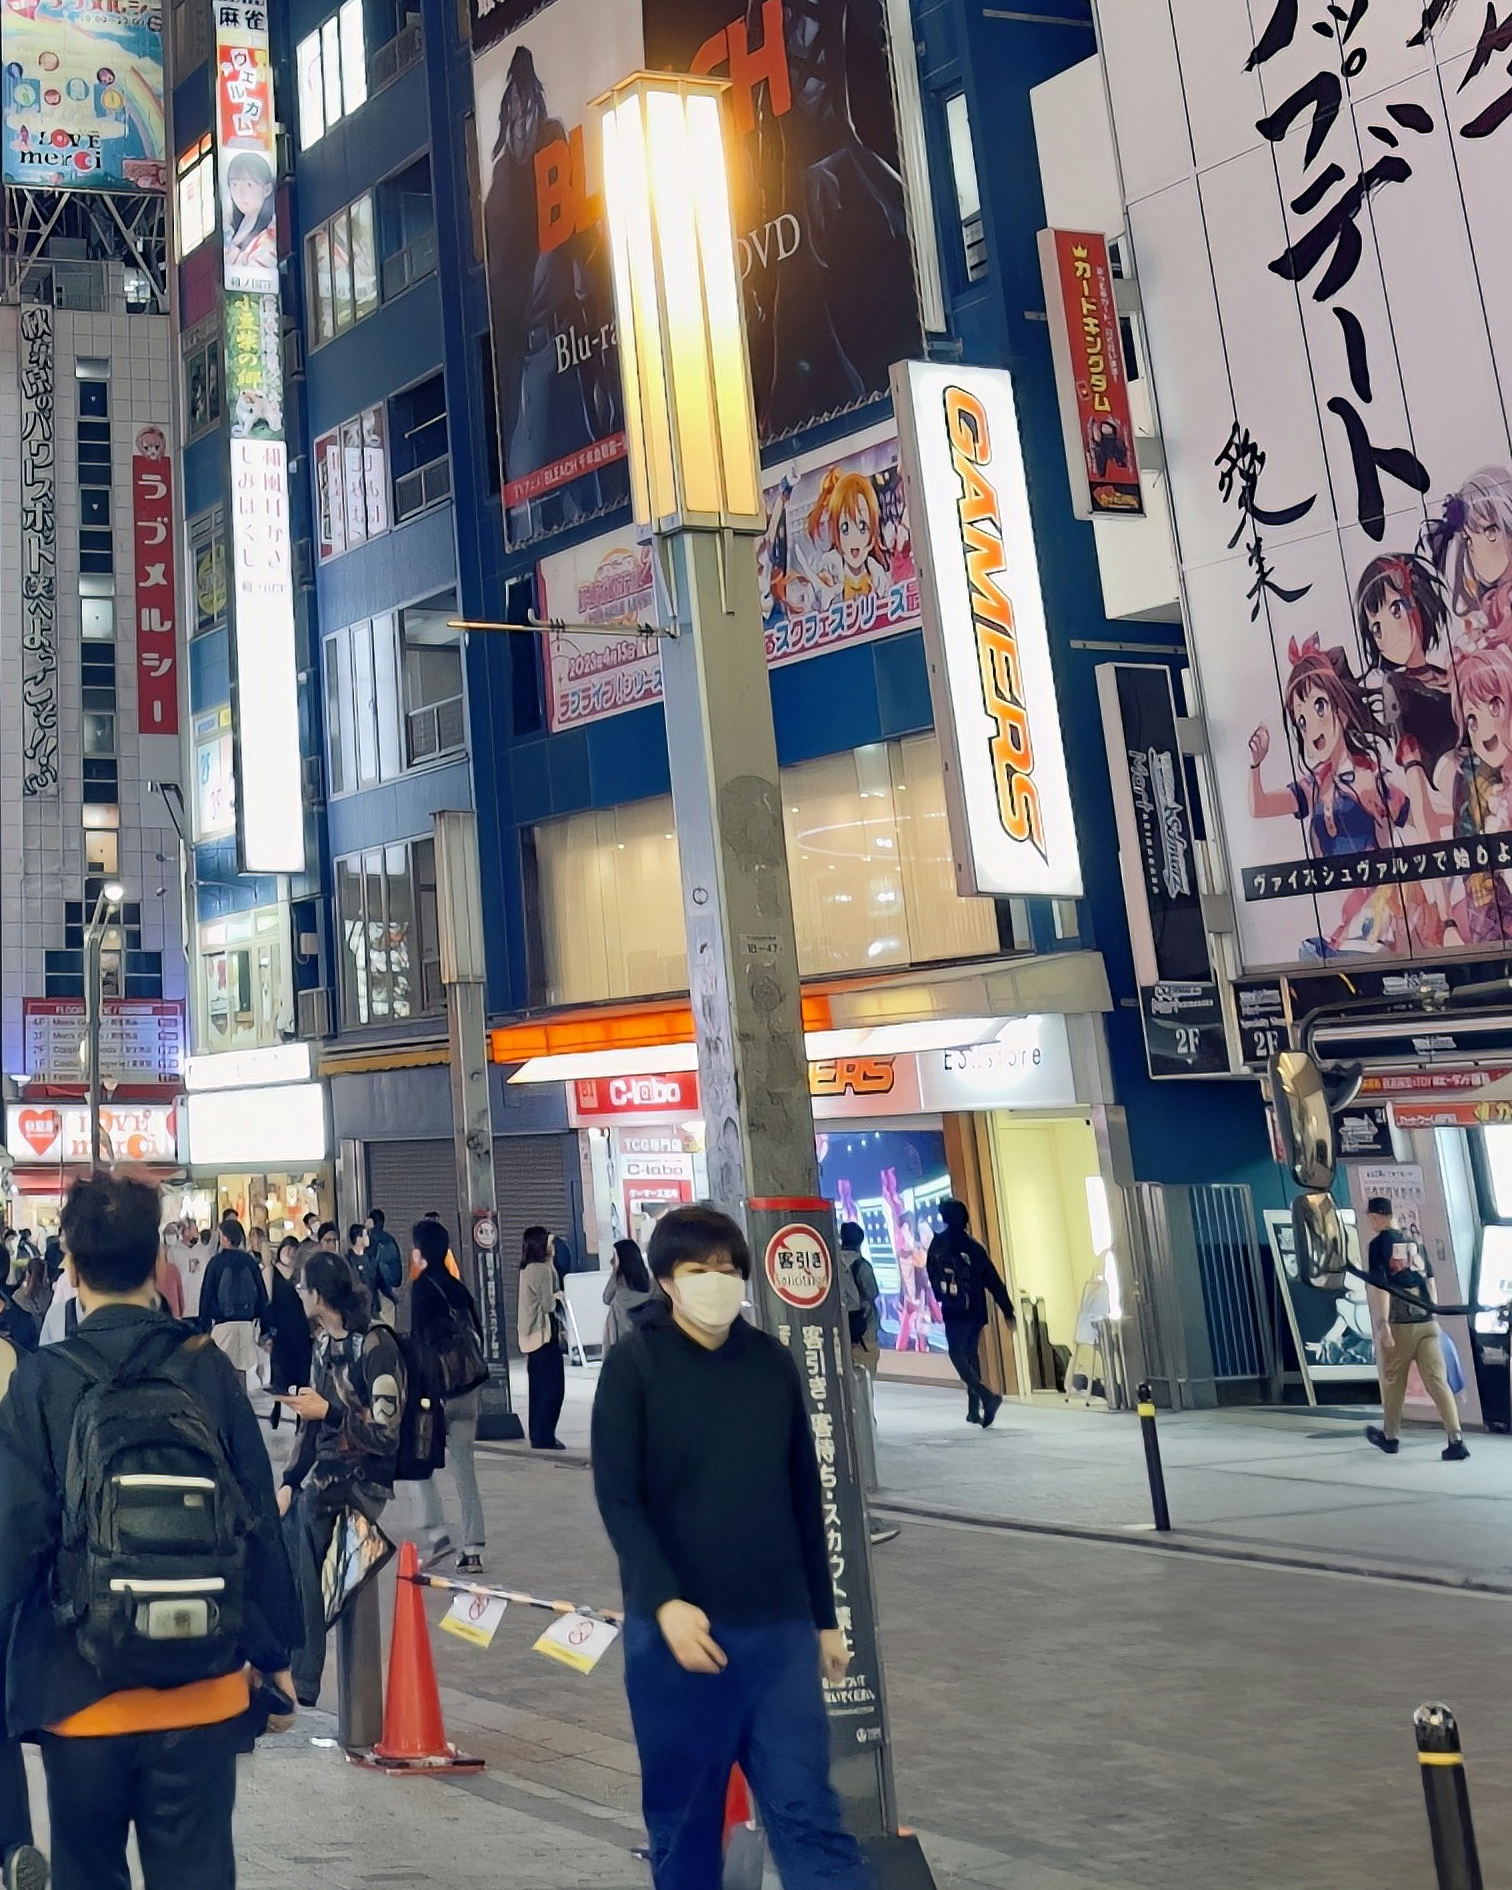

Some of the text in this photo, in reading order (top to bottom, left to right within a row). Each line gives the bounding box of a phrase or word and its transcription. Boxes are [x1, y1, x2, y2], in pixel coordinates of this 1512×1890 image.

[219, 6, 266, 33] 麻雀
[39, 129, 101, 150] LOVE
[20, 150, 102, 171] merci
[554, 316, 620, 374] Blu-ra
[137, 473, 173, 723] ラブメルシー
[944, 384, 1050, 867] GAMERS
[1175, 1027, 1201, 1056] 2F
[1253, 1030, 1279, 1057] 2F
[72, 1133, 158, 1158] mrci
[777, 1250, 823, 1272] 客引き
